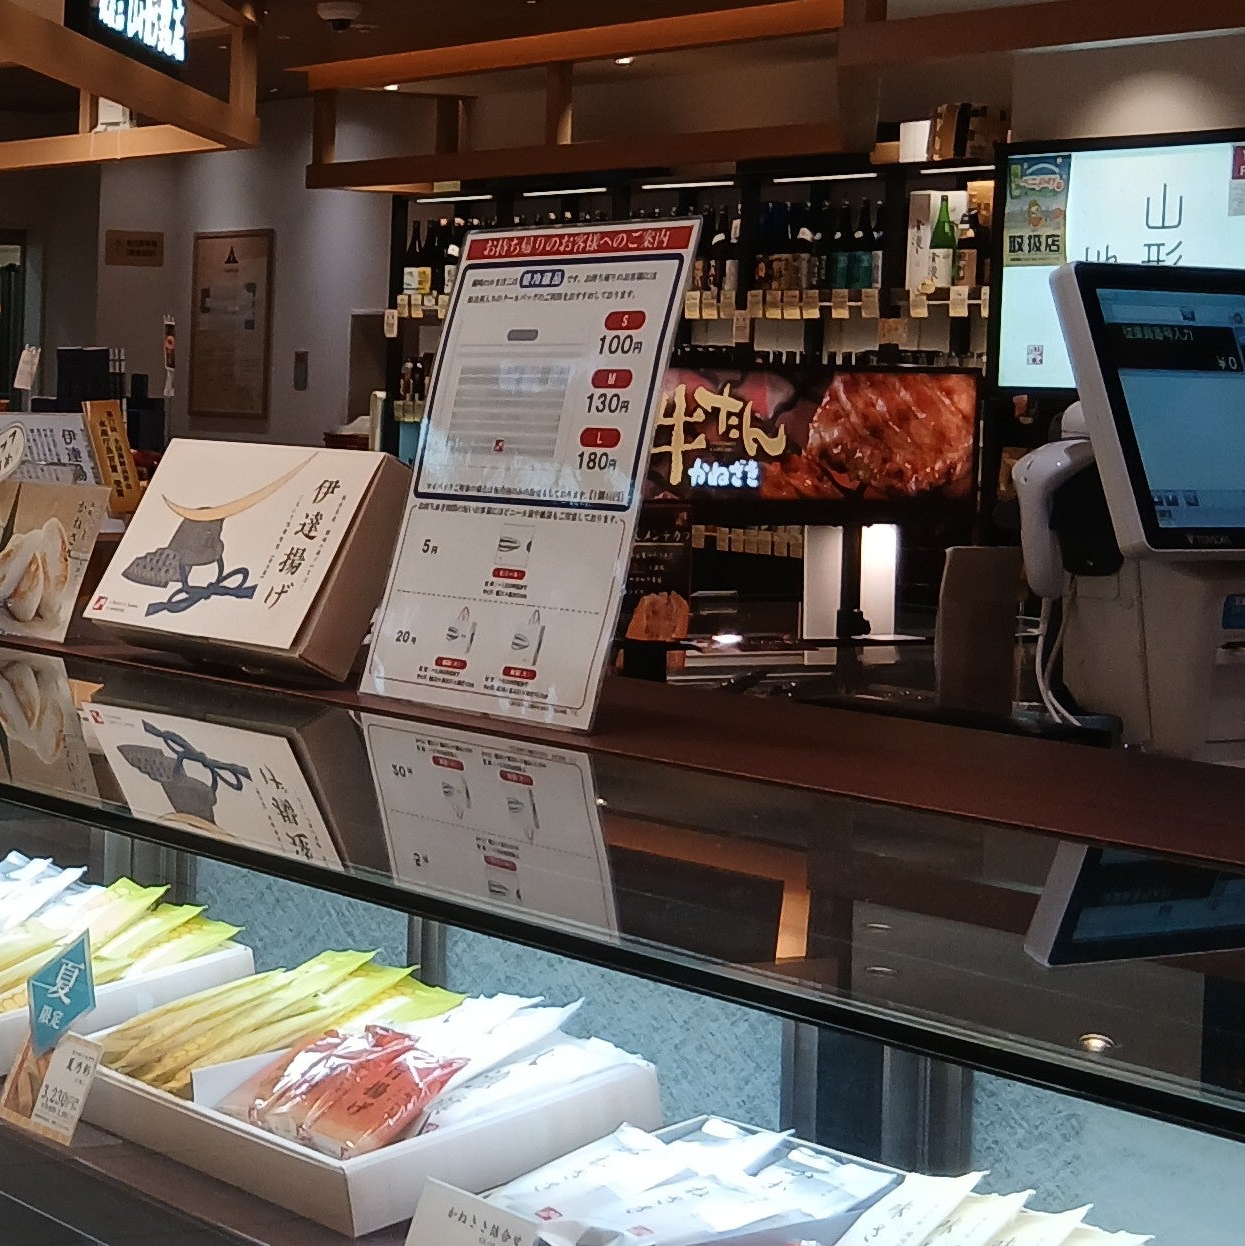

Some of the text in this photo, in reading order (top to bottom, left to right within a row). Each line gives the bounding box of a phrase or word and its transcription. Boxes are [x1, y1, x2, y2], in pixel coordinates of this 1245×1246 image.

[483, 229, 671, 257] お持ち帰りのお客様へのご案内
[1008, 233, 1061, 254] 取扱店
[620, 314, 630, 327] S
[598, 334, 643, 355] 100円
[607, 373, 617, 385] M
[586, 392, 630, 414] 130円
[651, 382, 787, 487] 牛たん
[576, 451, 617, 471] 180円
[687, 458, 761, 488] かねざき
[264, 479, 340, 610] 伊達揚げ
[47, 958, 86, 1005] 夏
[38, 1004, 64, 1031] 限定
